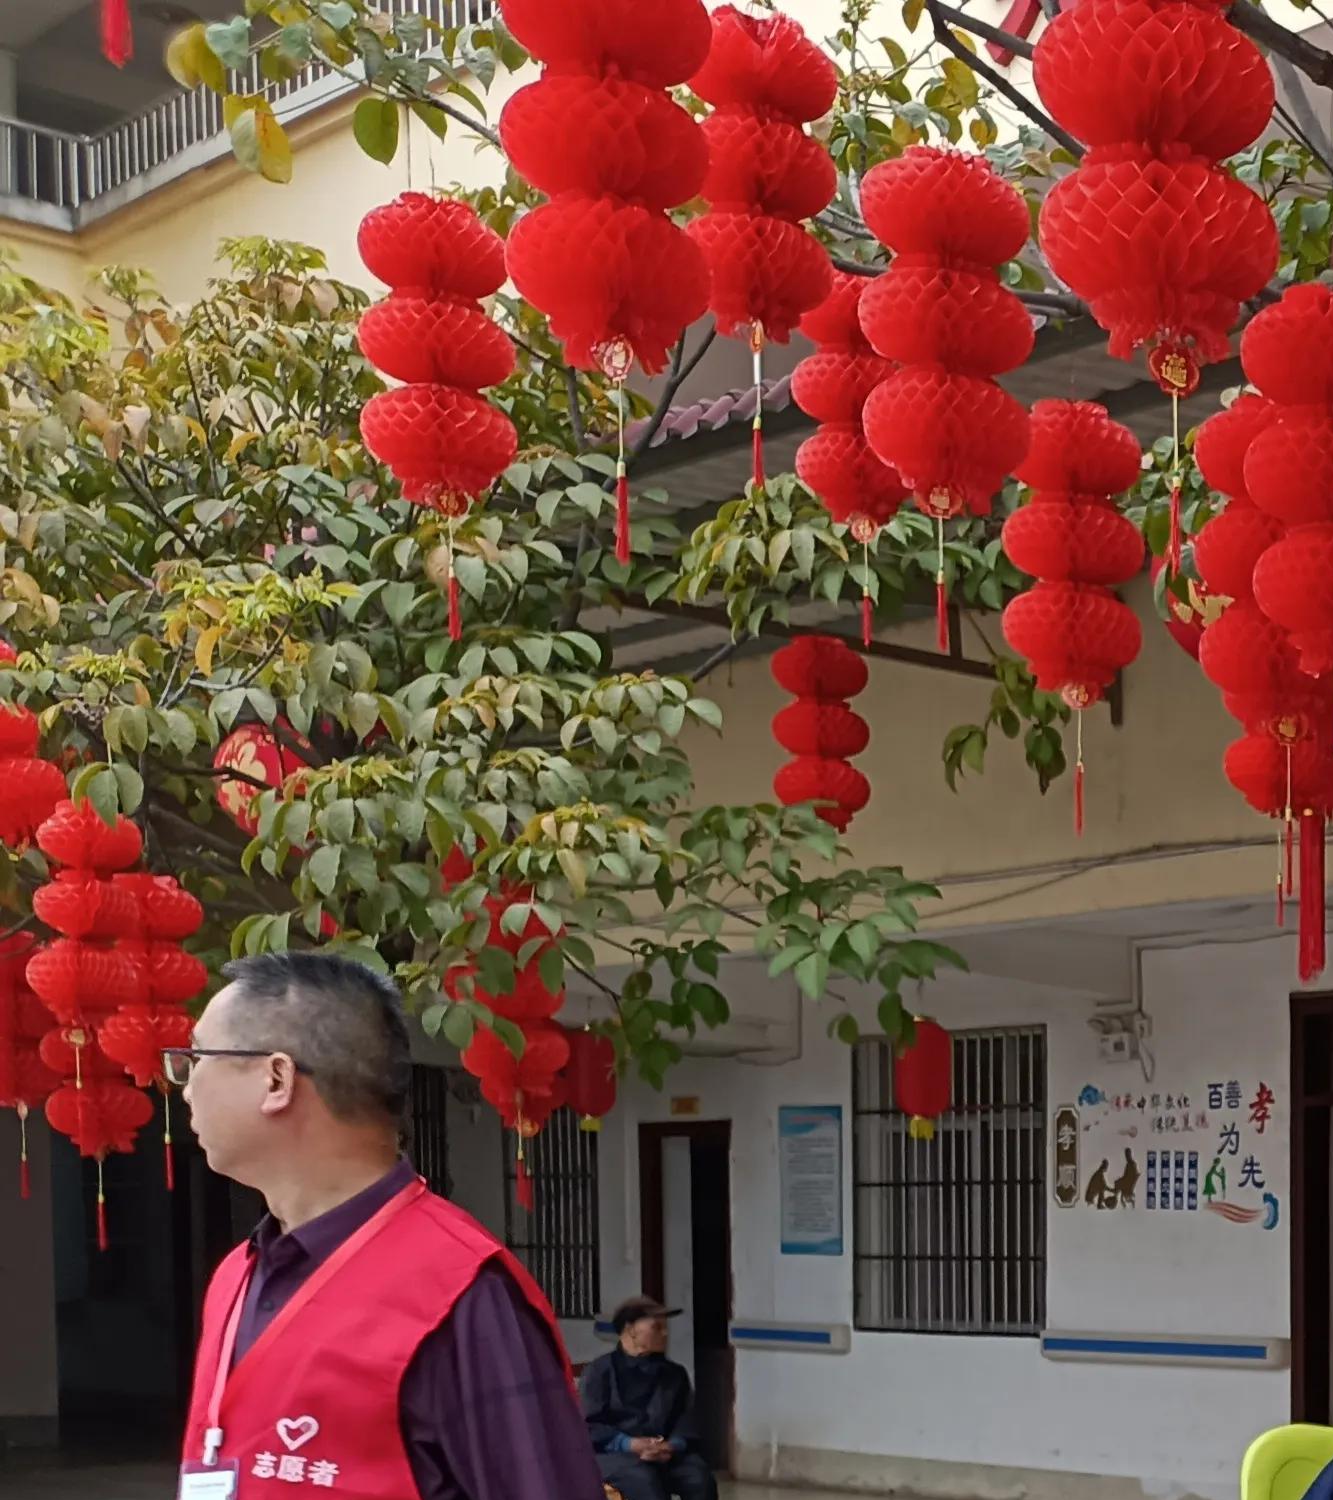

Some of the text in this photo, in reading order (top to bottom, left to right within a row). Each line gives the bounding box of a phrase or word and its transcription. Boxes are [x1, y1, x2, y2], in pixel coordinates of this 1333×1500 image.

[1207, 1080, 1243, 1110] 百善
[1248, 1081, 1275, 1134] 孝
[1217, 1122, 1240, 1156] 为
[1238, 1155, 1265, 1189] 先
[251, 1451, 340, 1488] 志愿者
